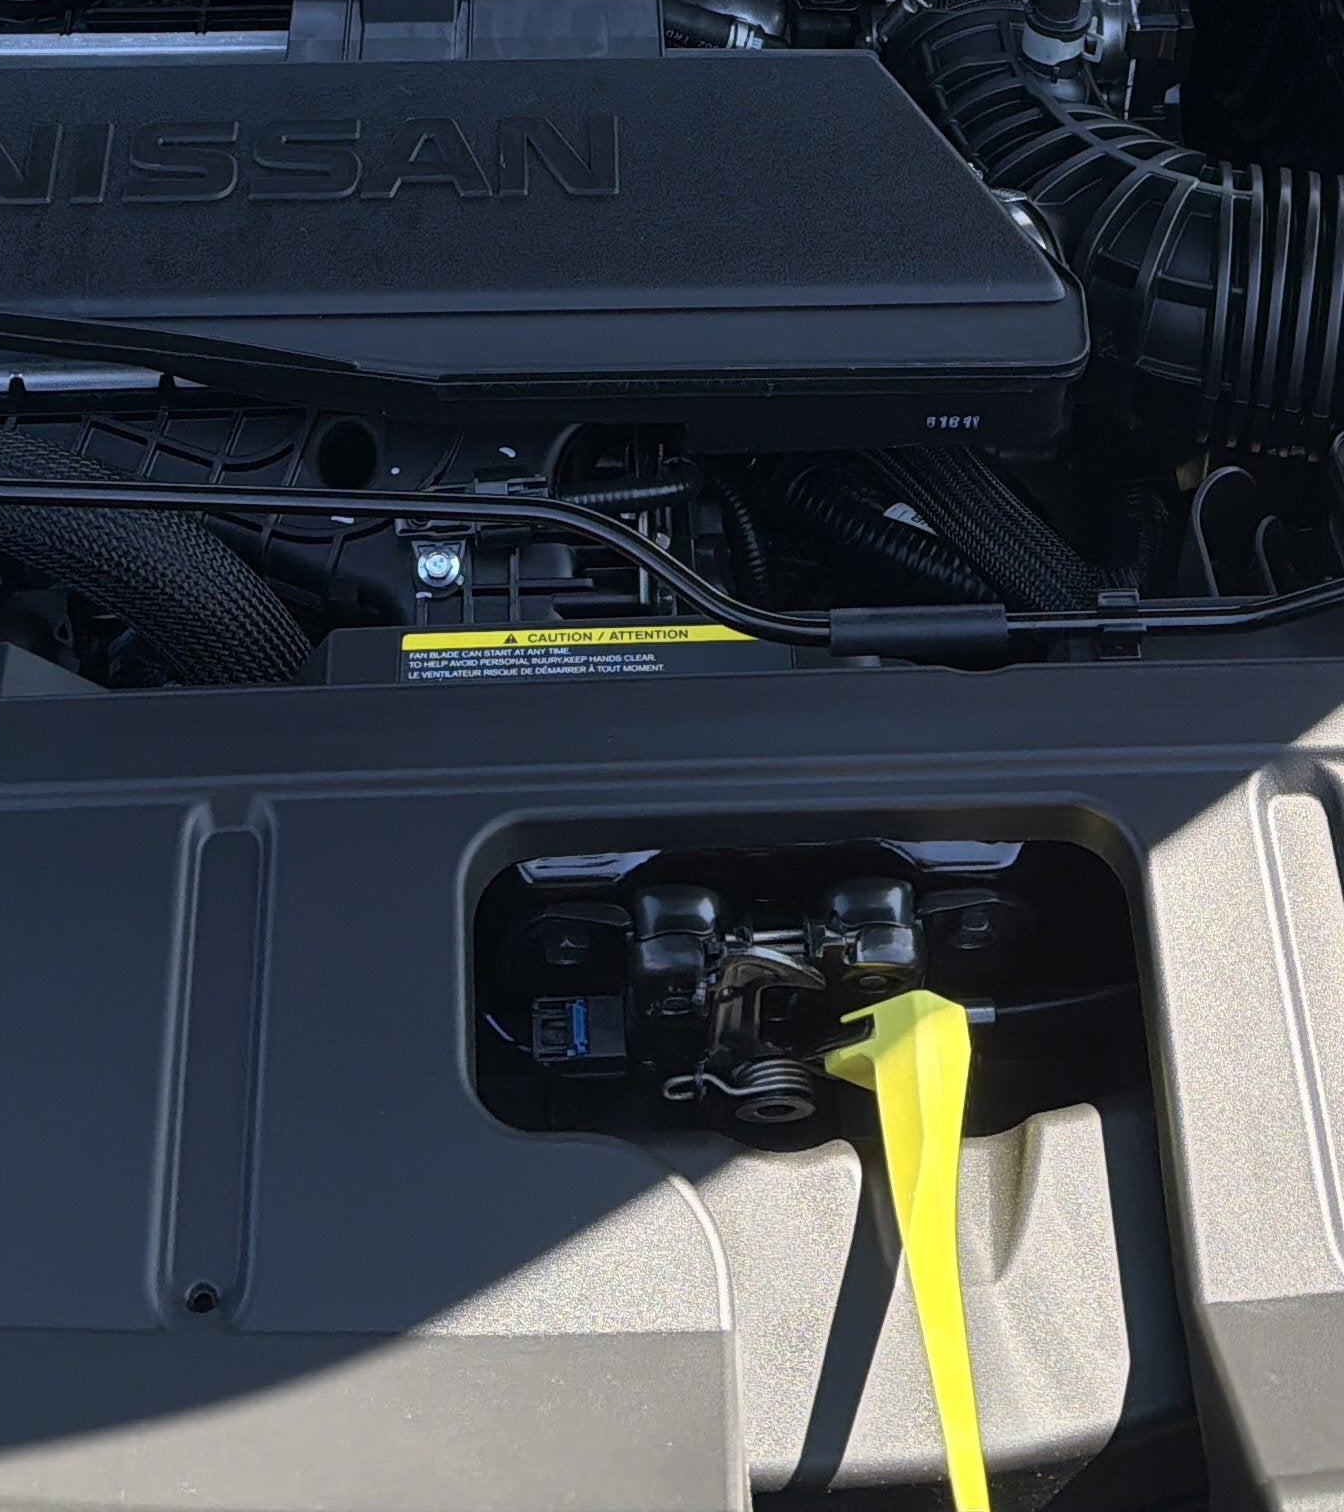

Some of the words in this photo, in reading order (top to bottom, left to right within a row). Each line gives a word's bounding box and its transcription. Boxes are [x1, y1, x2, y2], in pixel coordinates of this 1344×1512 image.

[527, 632, 592, 643] CAUTION
[609, 629, 688, 641] ATTENTION
[408, 651, 427, 659] FAN
[429, 650, 459, 659] BLADE
[461, 650, 482, 658] CAN
[483, 649, 512, 657] START
[513, 648, 525, 656] AT
[527, 647, 546, 656] ANY
[424, 660, 449, 668] HELP
[449, 659, 478, 667] AVOID
[479, 657, 529, 666] PERSONAL
[588, 654, 622, 663] HANDS
[623, 653, 656, 662] CLEAR.
[407, 671, 420, 679] LE
[421, 669, 482, 678] VENTILATEUR
[483, 668, 518, 677] RISQUE
[520, 667, 533, 675] DE
[535, 664, 587, 675] DÉMARRER
[597, 664, 621, 672] TOUT
